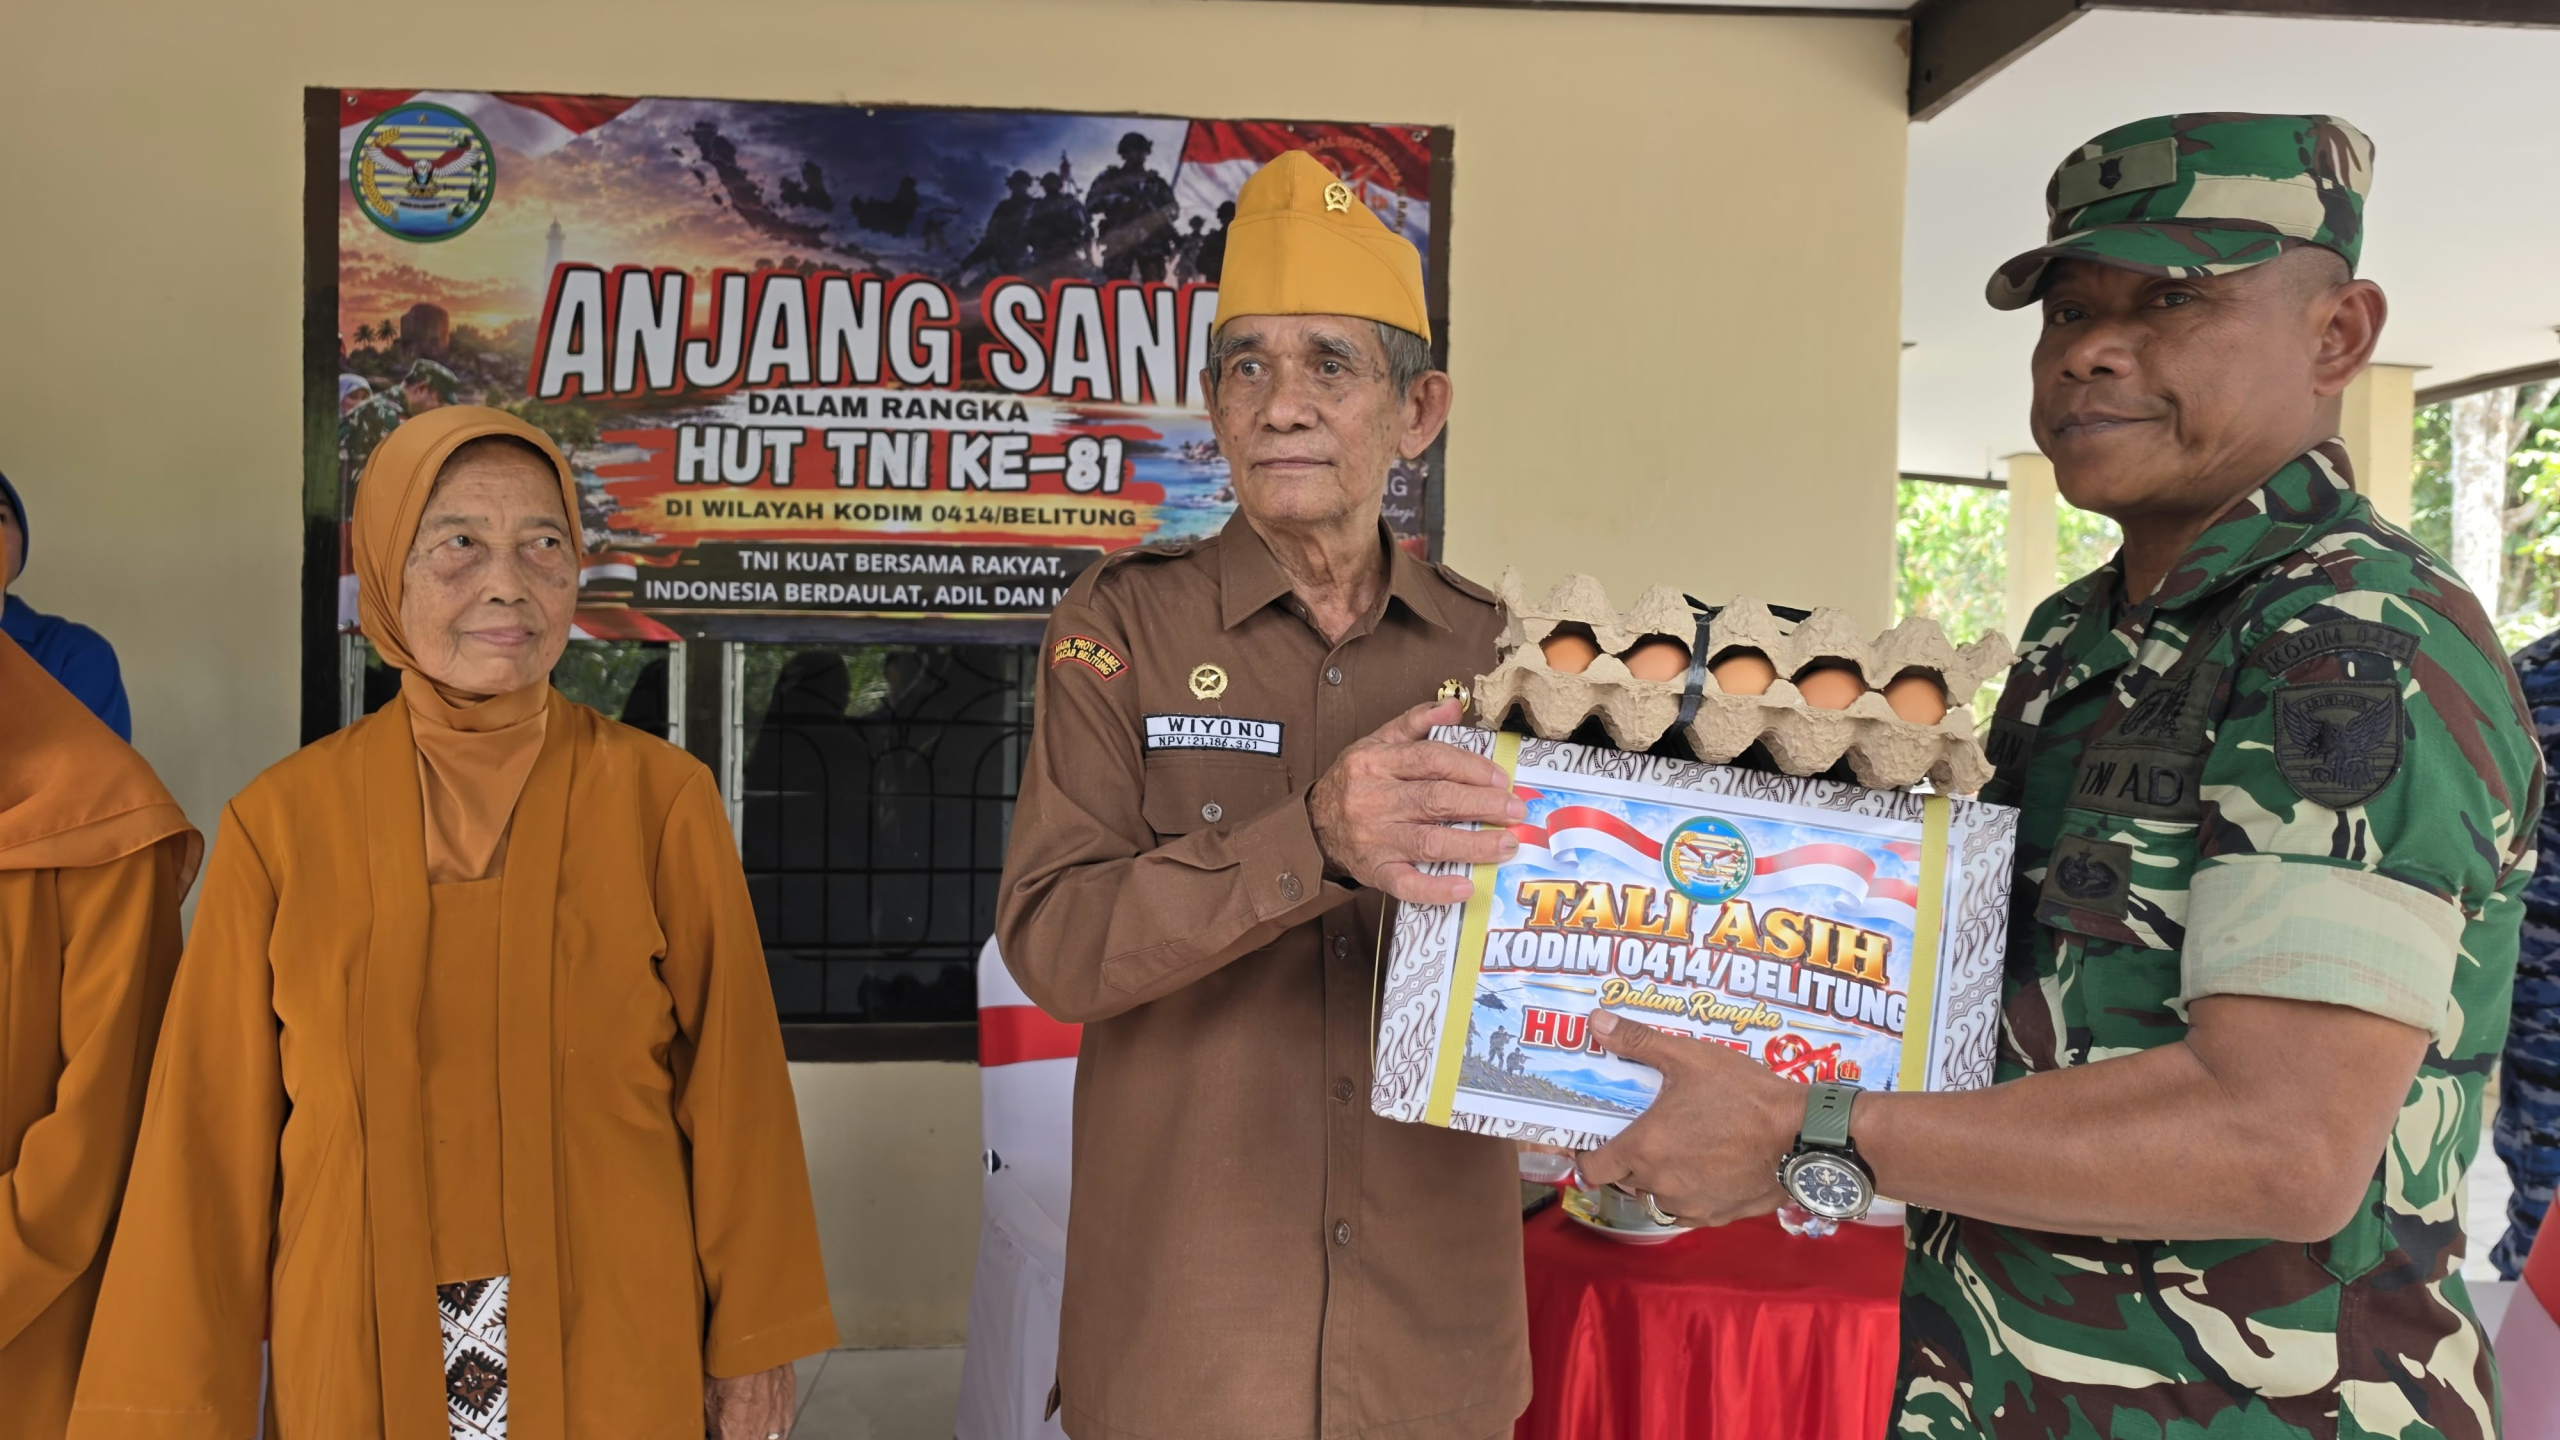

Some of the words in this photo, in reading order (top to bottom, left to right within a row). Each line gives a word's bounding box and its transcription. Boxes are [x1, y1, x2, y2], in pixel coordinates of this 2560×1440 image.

[536, 263, 955, 397] ANJANG
[748, 393, 870, 418] DALAM
[882, 397, 1028, 422] RANGKA
[679, 427, 802, 484] HUT
[827, 431, 929, 488] TNI
[951, 433, 1121, 492] KE-81
[666, 500, 692, 517] DI
[702, 501, 823, 520] WILAYAH
[834, 503, 922, 523] KODIM
[932, 505, 1136, 526] 0414/BELITUNG
[740, 551, 779, 570] TNI
[787, 552, 848, 571] KUAT
[856, 554, 965, 574] BERSAMA
[972, 556, 1066, 578] RAKYAT,
[646, 581, 778, 601] INDONESIA
[785, 583, 928, 607] BERDAULAT,
[934, 586, 988, 605] ADIL
[996, 587, 1045, 606] DAN
[1073, 639, 1096, 653] PROV.
[1097, 648, 1121, 672] BABEL
[1077, 650, 1112, 675] BELITUNG
[2268, 627, 2341, 668] KODIM
[1168, 718, 1264, 738] WIYONO
[2117, 763, 2185, 806] AD
[1521, 882, 1692, 940] TALI
[1711, 900, 1892, 985] ASIH
[1482, 930, 1608, 972] KODIM
[1619, 936, 1907, 1036] 0414/BELITUNG
[1600, 979, 1686, 1014] Dalam
[1689, 994, 1782, 1033] Rangka
